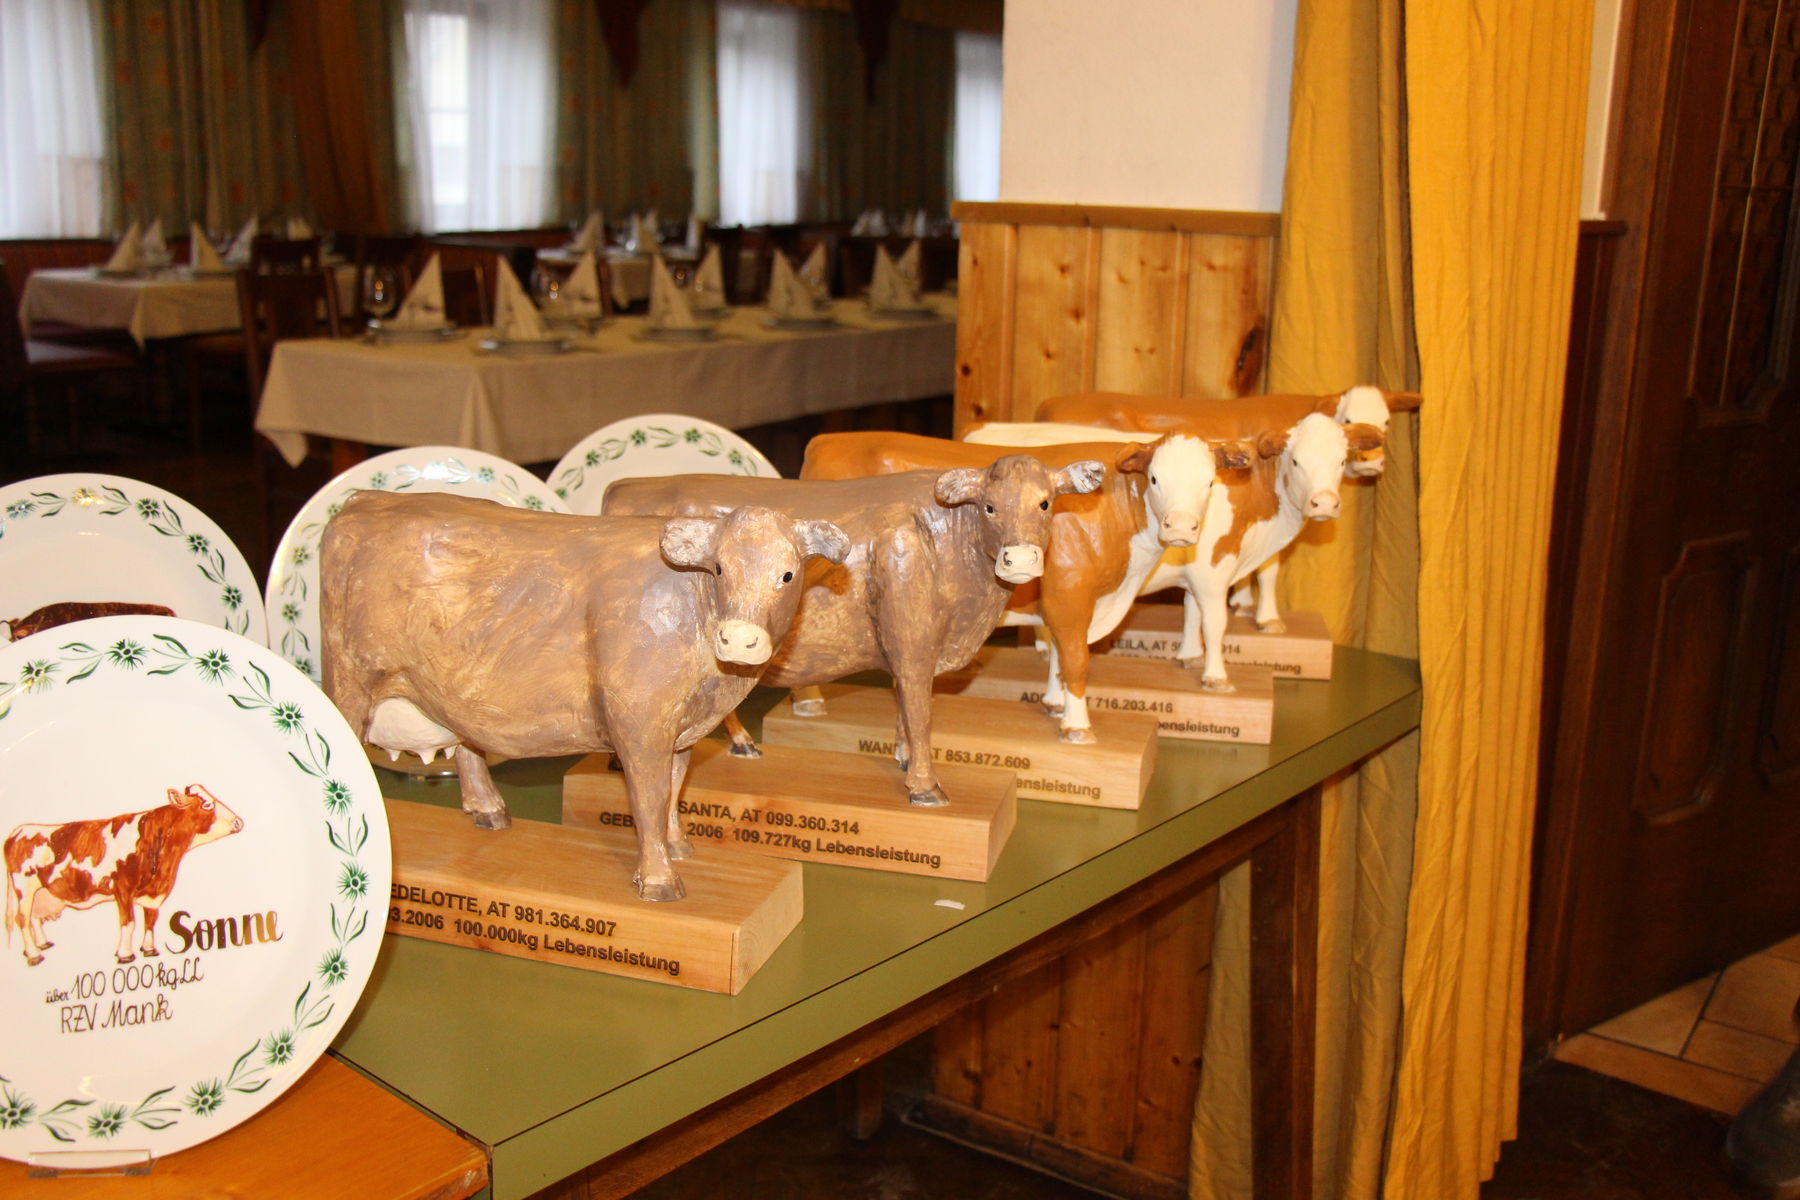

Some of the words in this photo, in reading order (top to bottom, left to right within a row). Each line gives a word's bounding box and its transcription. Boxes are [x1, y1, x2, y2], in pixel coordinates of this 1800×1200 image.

[1151, 640, 1168, 652] AT
[1096, 696, 1174, 713] 716.203.416
[859, 739, 897, 755] WAN
[946, 748, 1031, 770] 853.872.609
[677, 800, 737, 824] SANTA,
[740, 807, 762, 824] AT
[766, 810, 860, 836] 099.360.314
[733, 827, 812, 854] 109.727kg
[815, 837, 942, 870] Lebensleistung
[165, 910, 283, 954] Sonne
[487, 901, 511, 918] AT
[514, 904, 618, 938] 981.364.907
[388, 906, 445, 930] 3.2006
[454, 918, 539, 951] 100.000kg
[543, 934, 680, 977] Lebensleistung
[71, 971, 106, 1000] 100
[61, 1002, 98, 1034] RZV
